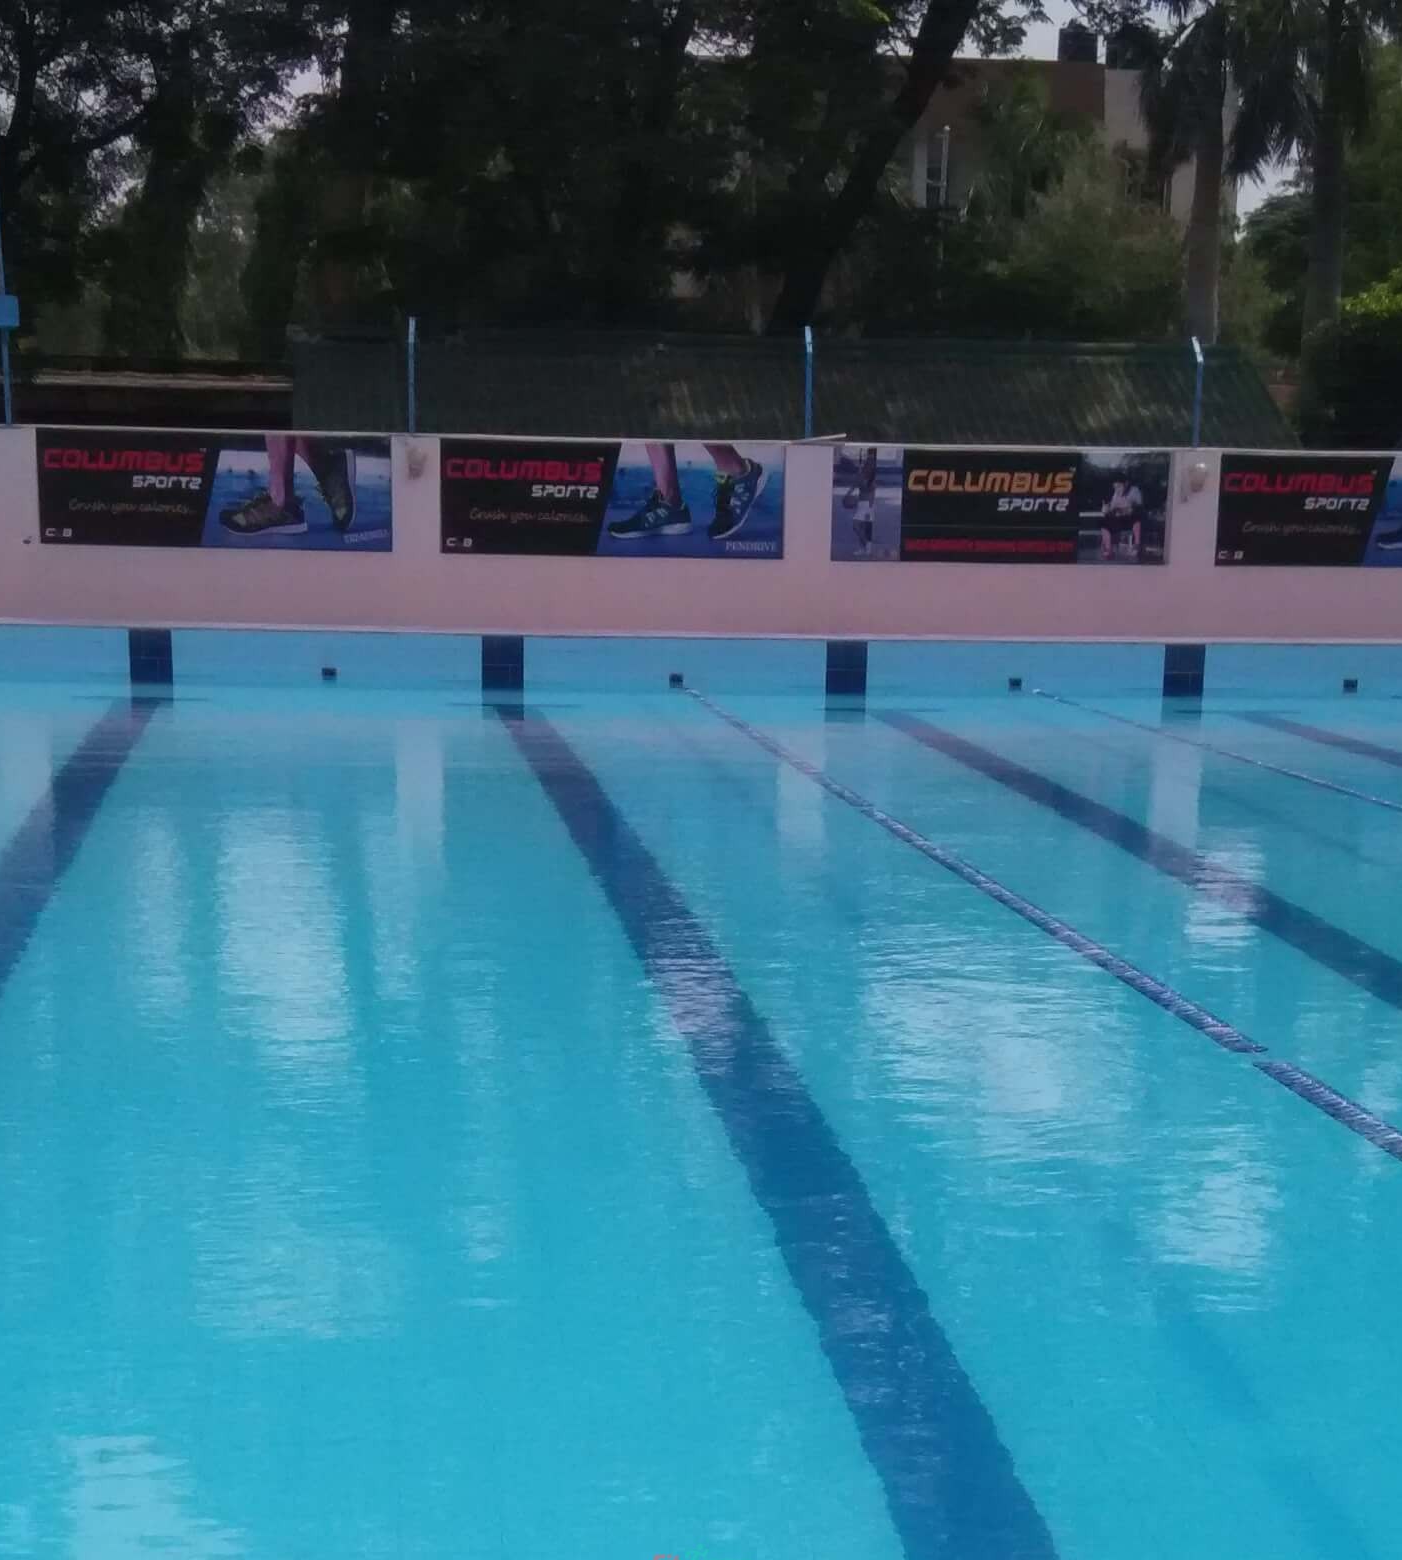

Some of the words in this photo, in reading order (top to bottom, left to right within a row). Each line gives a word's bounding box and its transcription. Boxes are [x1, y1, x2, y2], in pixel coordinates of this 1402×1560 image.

[43, 448, 204, 473] COLUMBUS
[447, 457, 602, 481] COLUMBUS
[908, 469, 1074, 493] COLUMBUS
[1223, 472, 1374, 494] COLUMBUS
